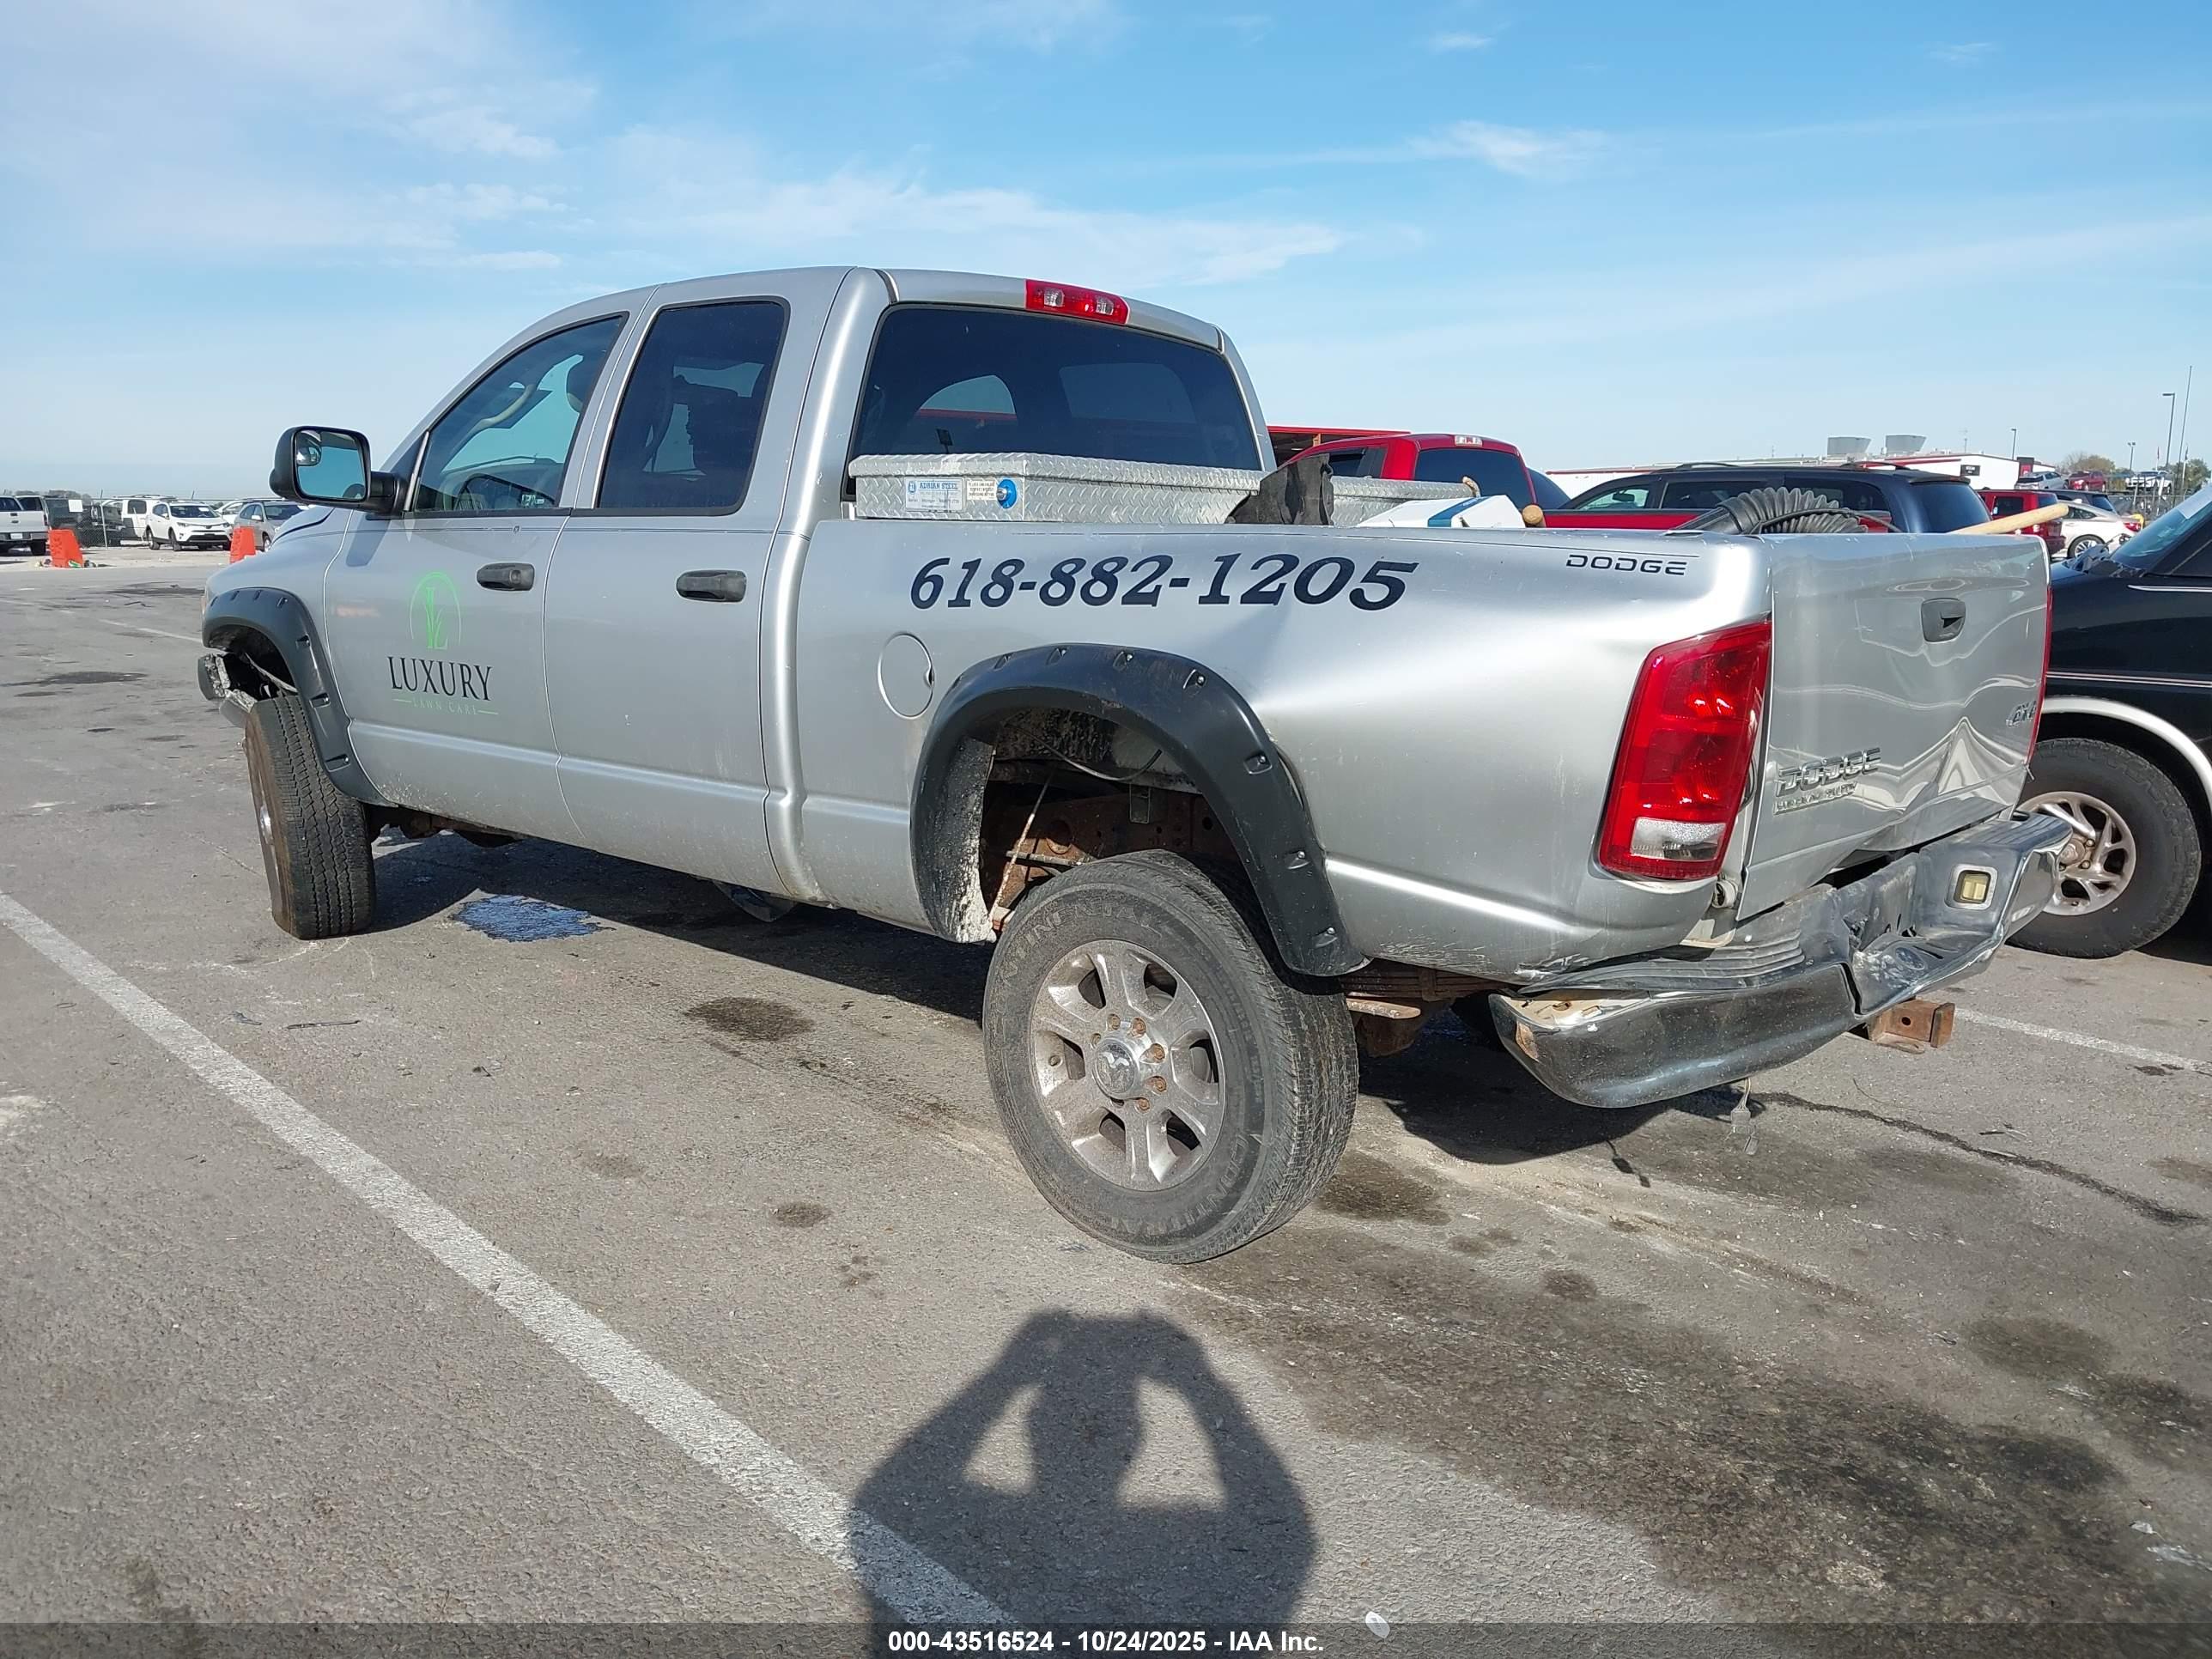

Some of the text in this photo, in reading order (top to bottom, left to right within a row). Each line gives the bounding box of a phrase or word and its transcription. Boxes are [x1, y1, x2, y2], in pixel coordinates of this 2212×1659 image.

[910, 553, 1419, 611] 618-882-1205
[1566, 554, 1687, 576] DODGE
[387, 656, 493, 701] LUXURY
[1776, 747, 1881, 797] DODGE
